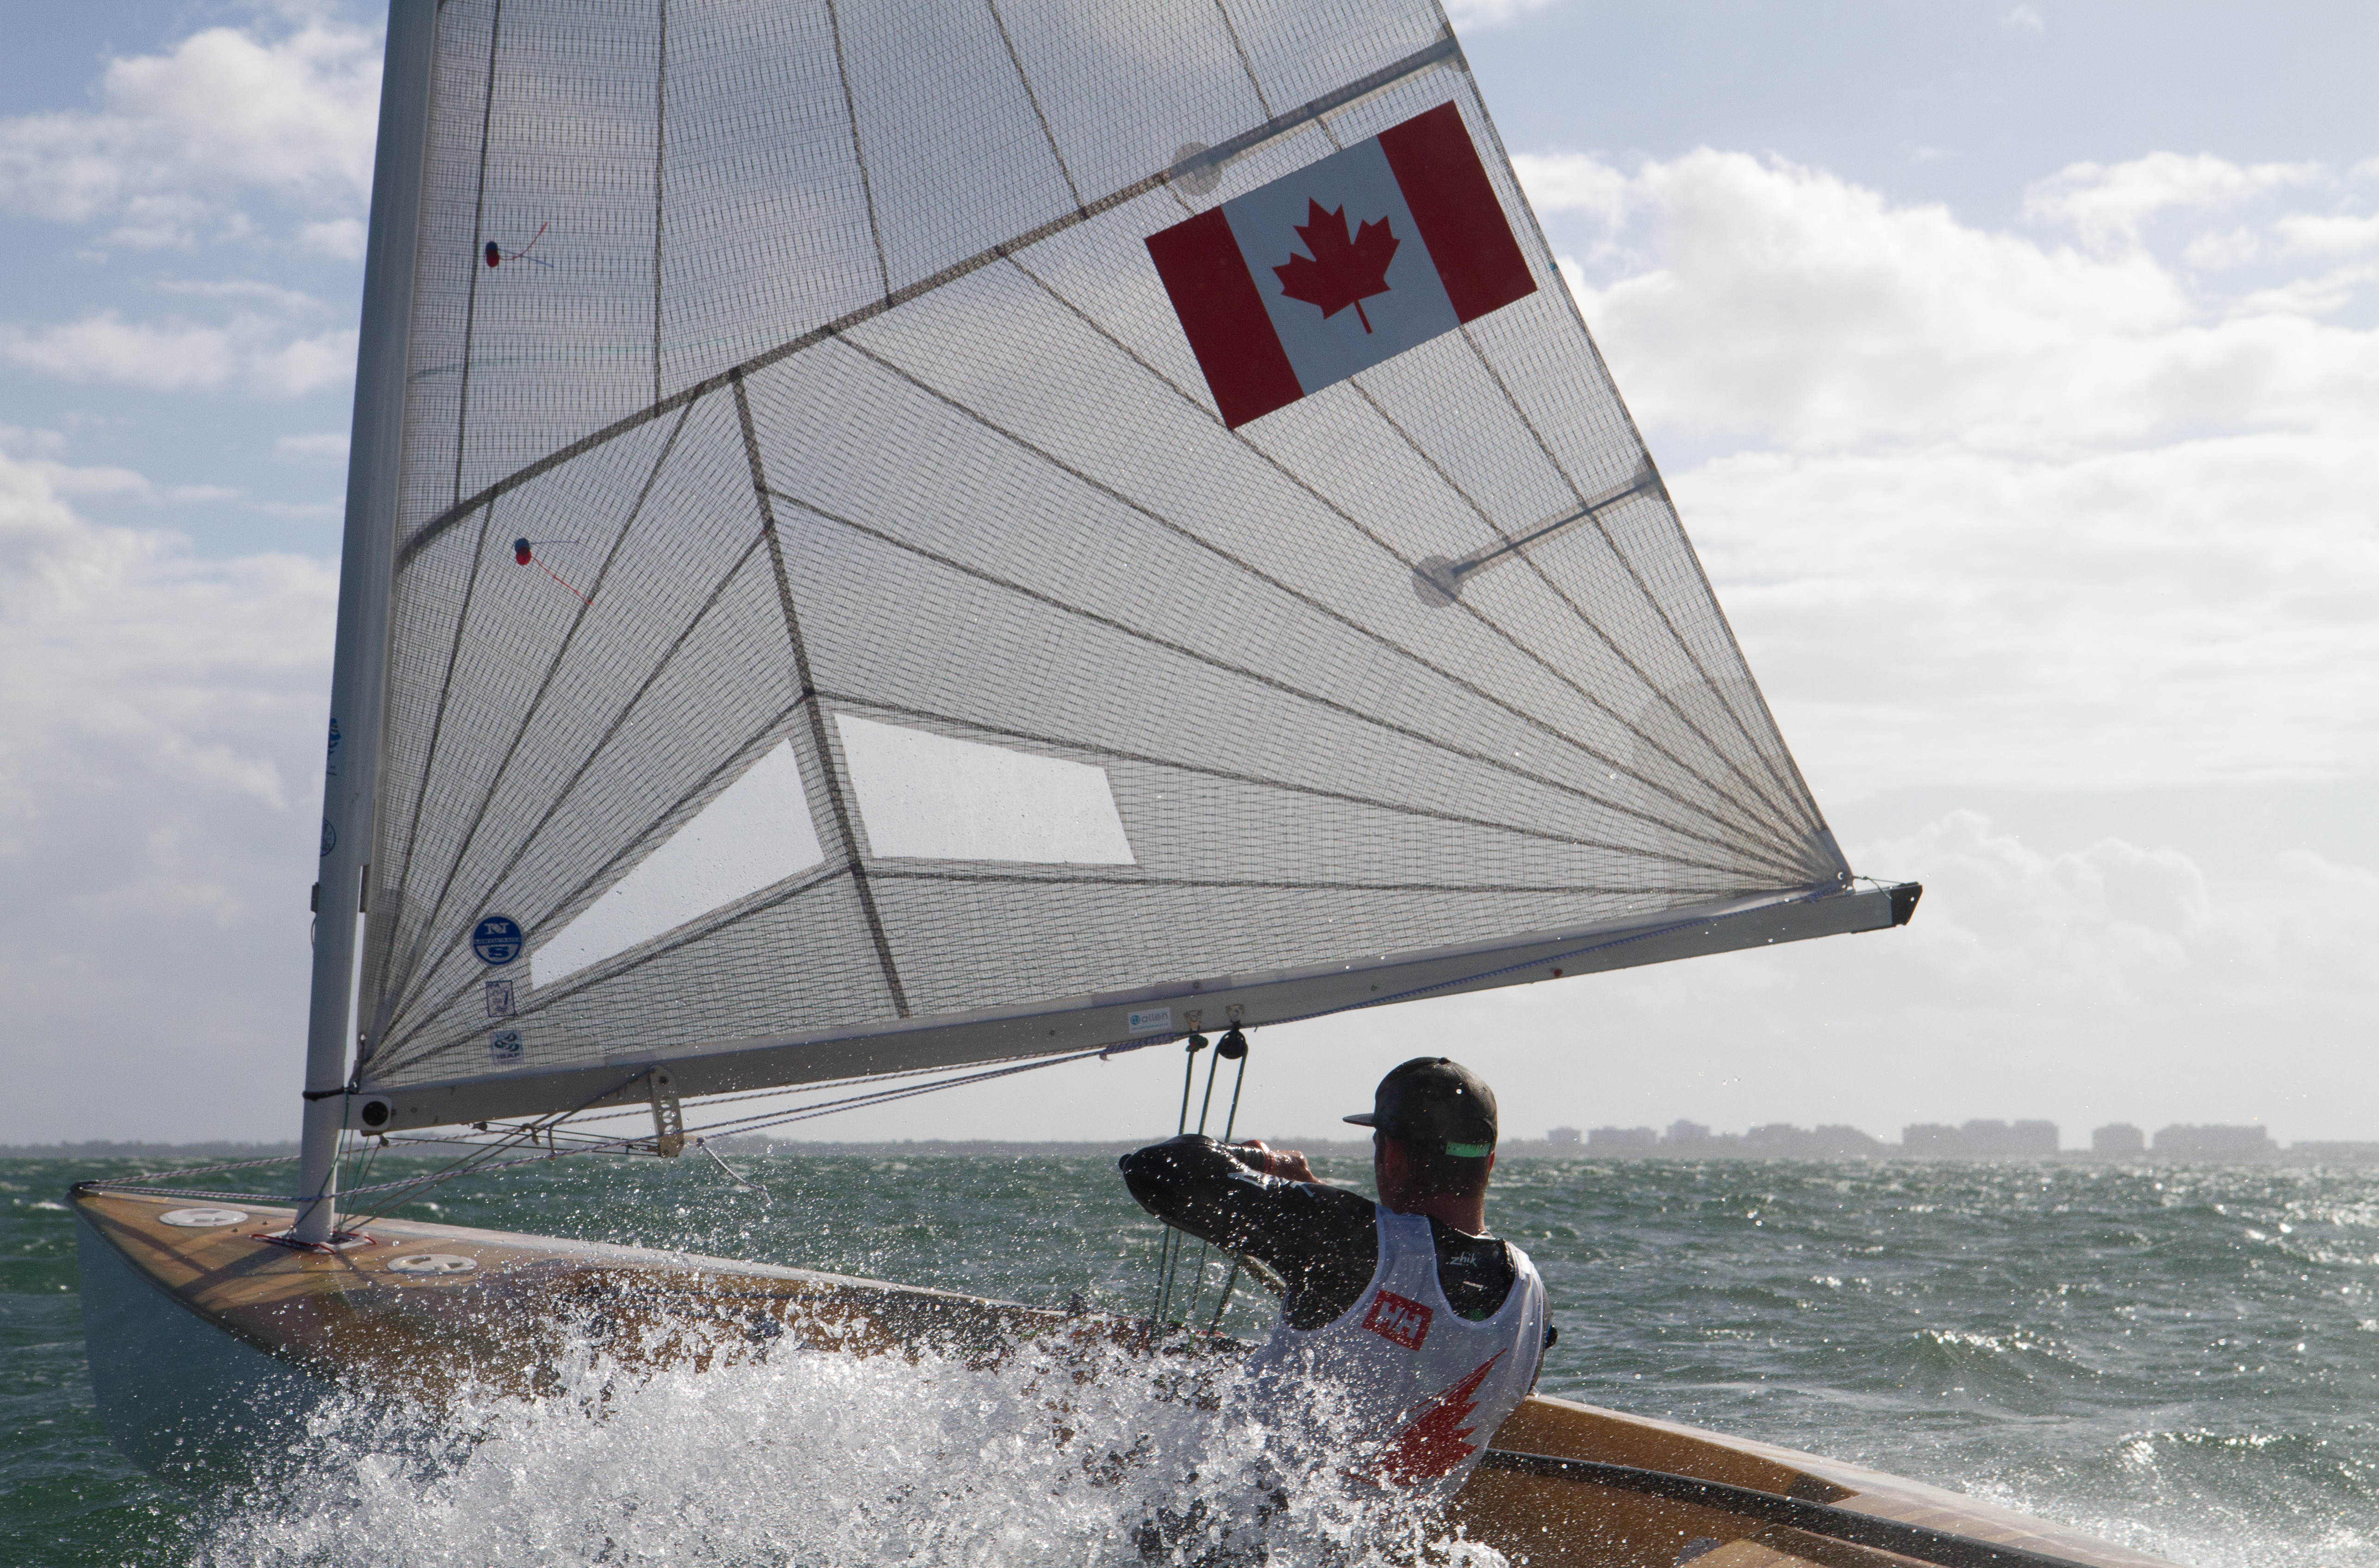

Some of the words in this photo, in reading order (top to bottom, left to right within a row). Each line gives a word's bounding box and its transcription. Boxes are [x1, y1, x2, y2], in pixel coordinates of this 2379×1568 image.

[484, 922, 510, 934] N
[488, 946, 509, 958] S
[1141, 1012, 1168, 1023] allen
[1450, 1251, 1477, 1267] zhik
